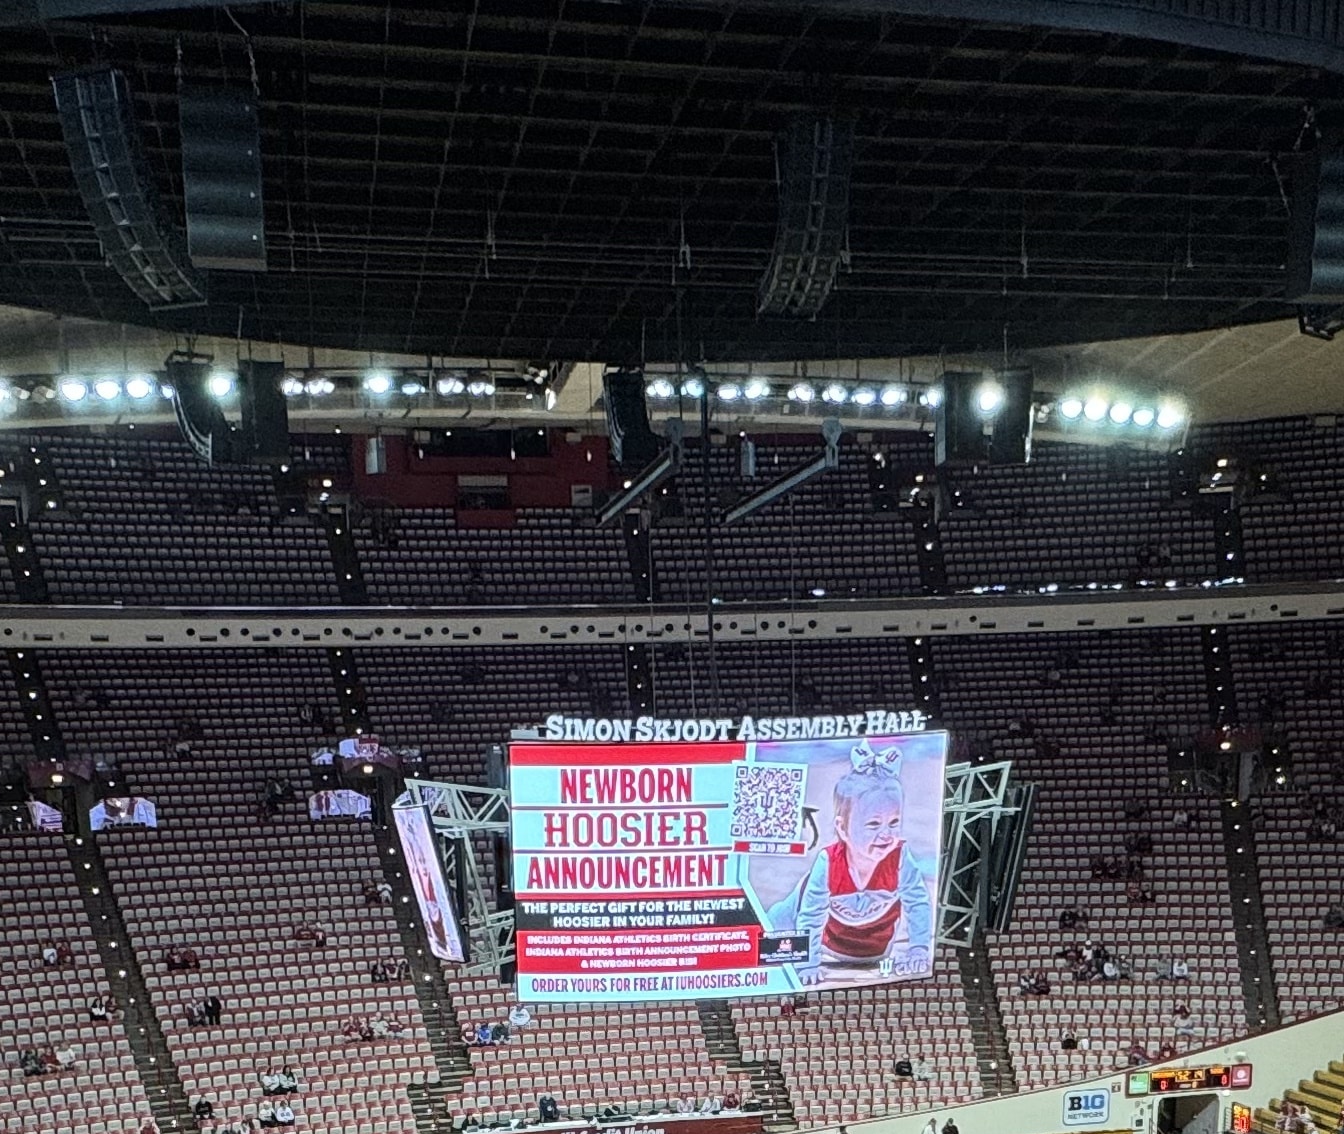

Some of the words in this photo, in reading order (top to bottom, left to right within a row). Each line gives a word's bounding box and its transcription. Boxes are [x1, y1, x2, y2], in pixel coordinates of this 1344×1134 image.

[546, 716, 632, 742] SIMON
[634, 715, 732, 742] SKJODT
[738, 715, 863, 741] ASSEMBLY
[864, 709, 927, 735] HALL
[560, 767, 693, 804] NEWBORN
[544, 811, 709, 848] HOOSIER
[527, 853, 729, 890] ANNOUNCEMENT
[522, 902, 548, 914] THE
[550, 902, 606, 914] PERFECT
[607, 901, 637, 913] GIFT
[638, 900, 665, 913] FOR
[667, 900, 691, 912] THE
[693, 898, 745, 911] NEWEST
[553, 915, 610, 928] HOOSIER
[612, 915, 627, 927] IN
[628, 914, 664, 927] YOUR
[665, 913, 715, 926] FAMILY!
[531, 977, 569, 993] ORDER
[570, 977, 607, 992] YOURS
[610, 977, 631, 992] FOR
[633, 976, 659, 991] FREE
[660, 976, 674, 991] AT
[675, 972, 768, 991] IUHOOSIERS.COM
